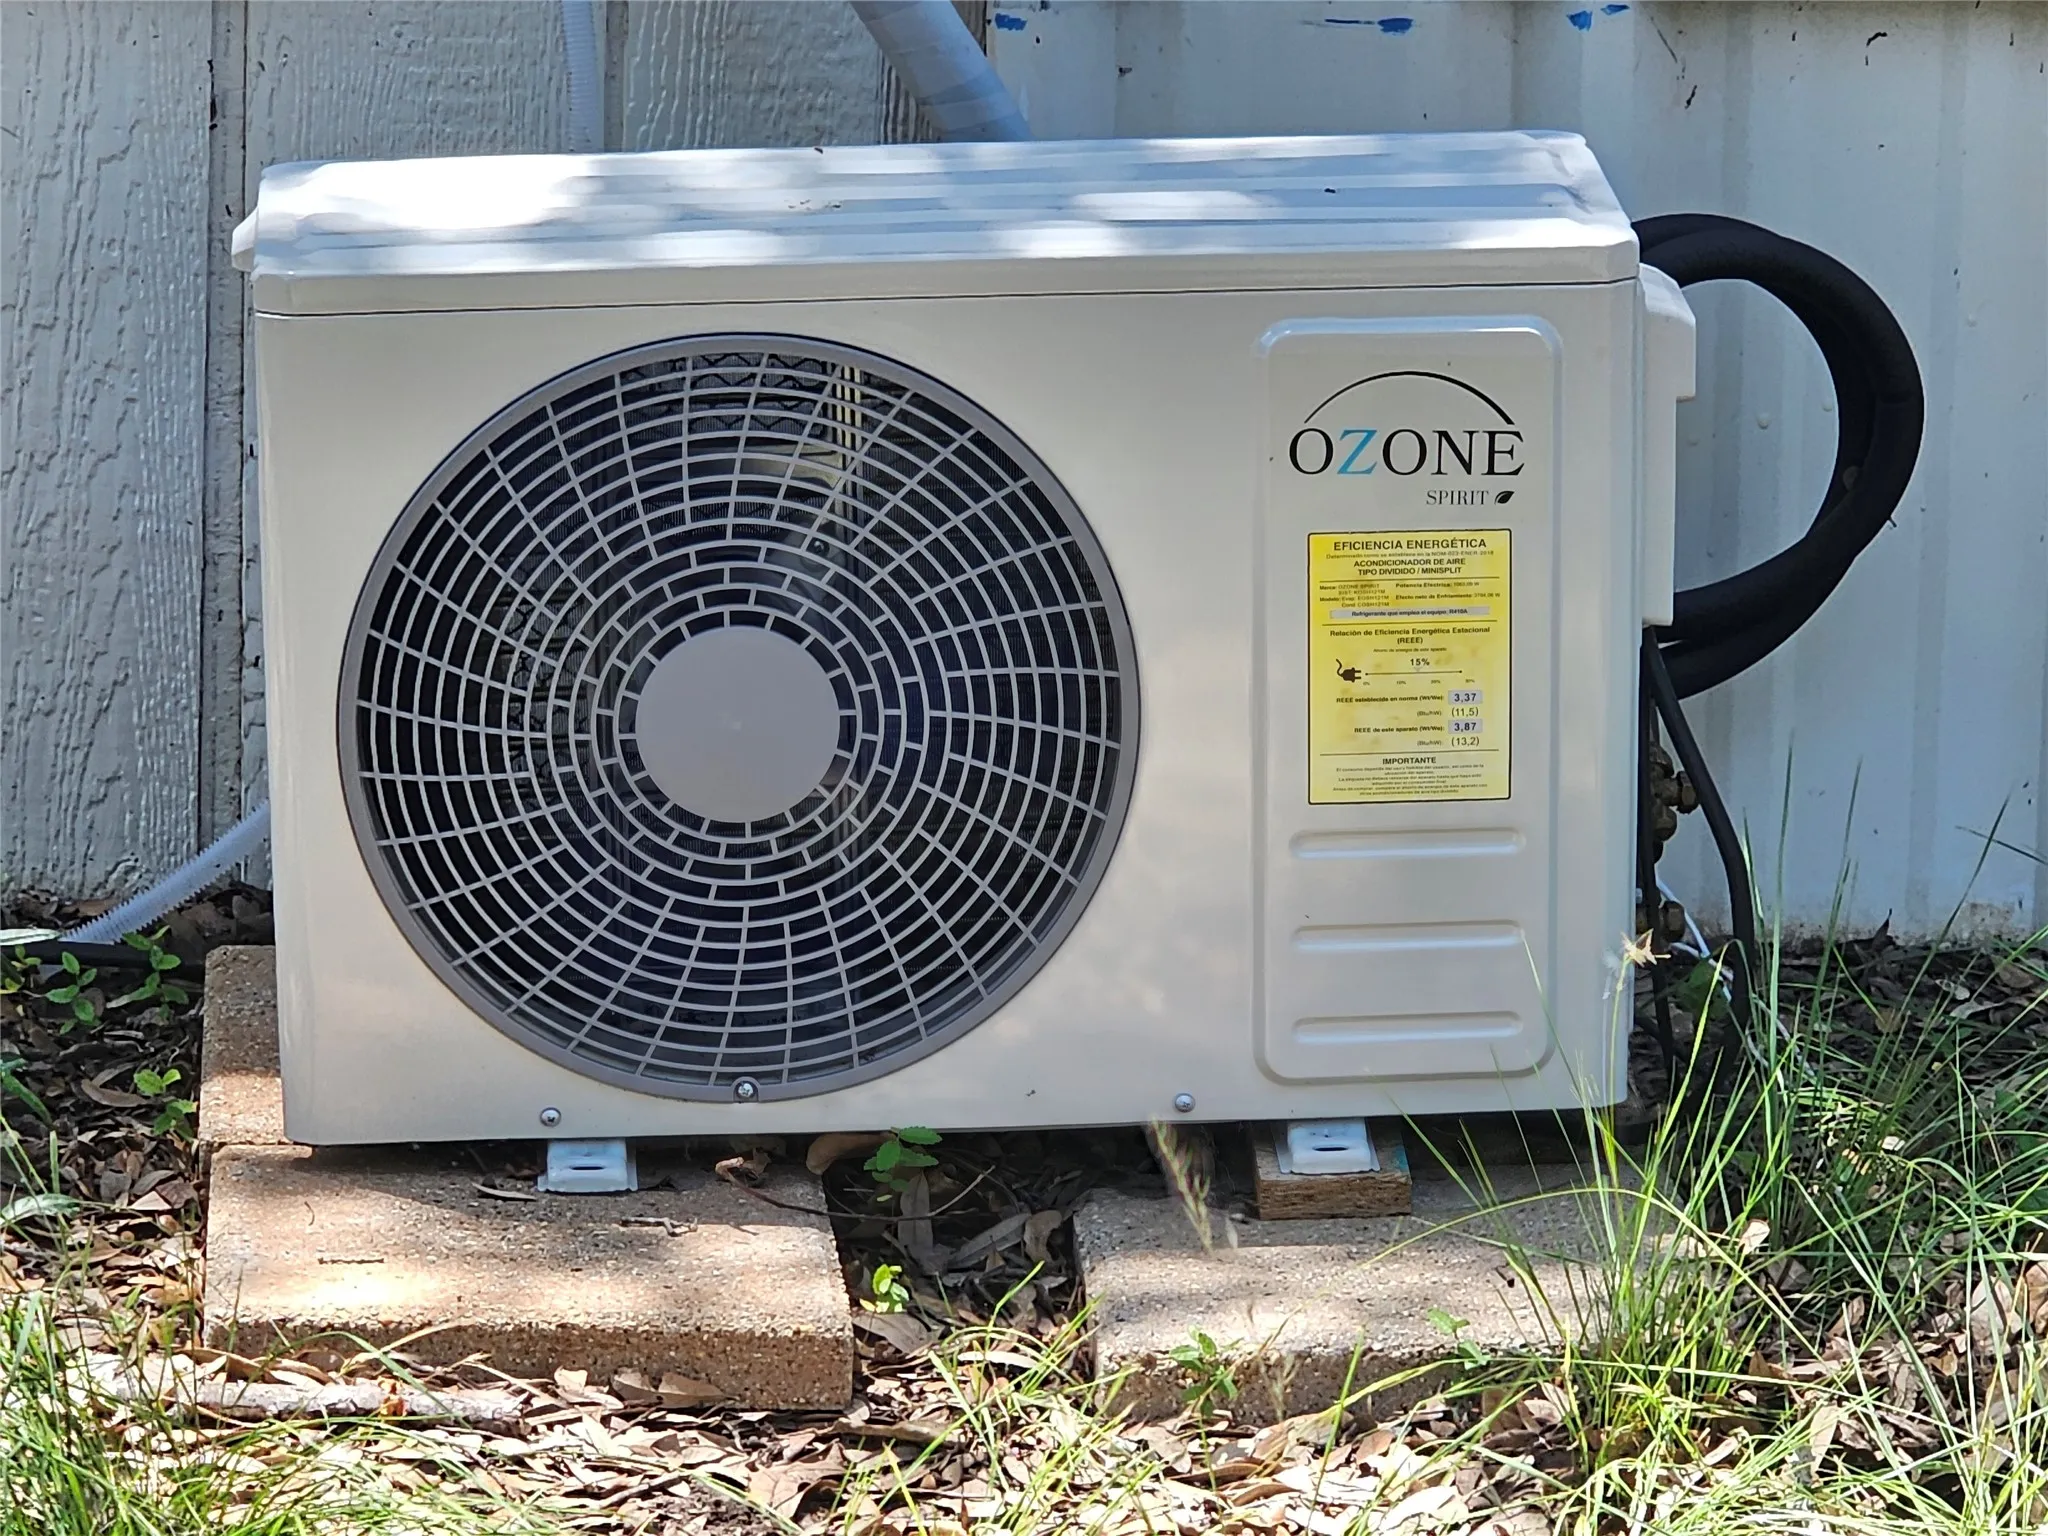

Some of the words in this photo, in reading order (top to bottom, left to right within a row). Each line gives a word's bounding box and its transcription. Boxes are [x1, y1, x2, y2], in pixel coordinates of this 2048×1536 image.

[1289, 428, 1525, 476] OZONE
[1426, 490, 1489, 506] SPIRIT
[1334, 540, 1403, 551] EFICIENCIA
[1407, 537, 1487, 549] ENERGÉTICA
[1354, 559, 1431, 567] ACONDICIONADOR
[1412, 628, 1450, 636] Energética
[1454, 693, 1477, 703] 3,37
[1451, 707, 1479, 718] (11,5)
[1454, 722, 1477, 732] 3,87
[1451, 737, 1480, 747] (13,2)
[1383, 757, 1437, 765] IMPORTANTE
